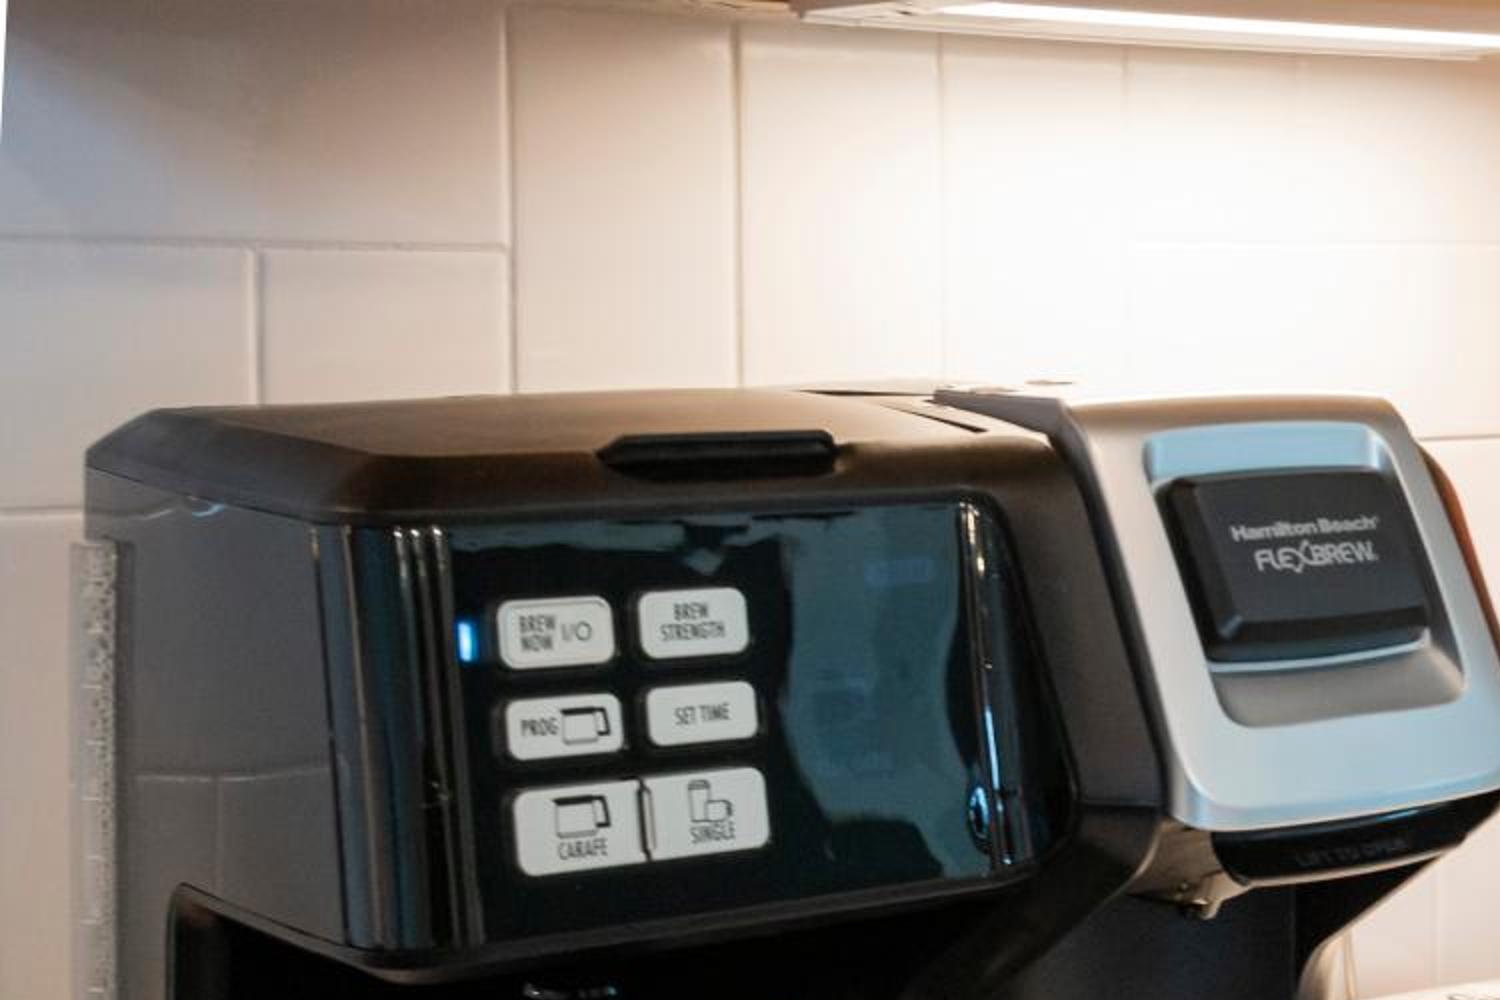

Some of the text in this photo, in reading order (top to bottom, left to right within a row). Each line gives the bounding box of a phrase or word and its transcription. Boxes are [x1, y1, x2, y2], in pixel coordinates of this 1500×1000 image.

[1229, 515, 1378, 542] Hamilton Beach
[673, 603, 709, 621] BREW
[519, 615, 556, 634] BREW
[659, 620, 727, 642] STRENGTH
[520, 635, 554, 652] NOW
[675, 703, 730, 726] SET TIME
[521, 717, 558, 737] PROG
[689, 821, 736, 844] SINGLE
[557, 838, 609, 861] CARAFE
